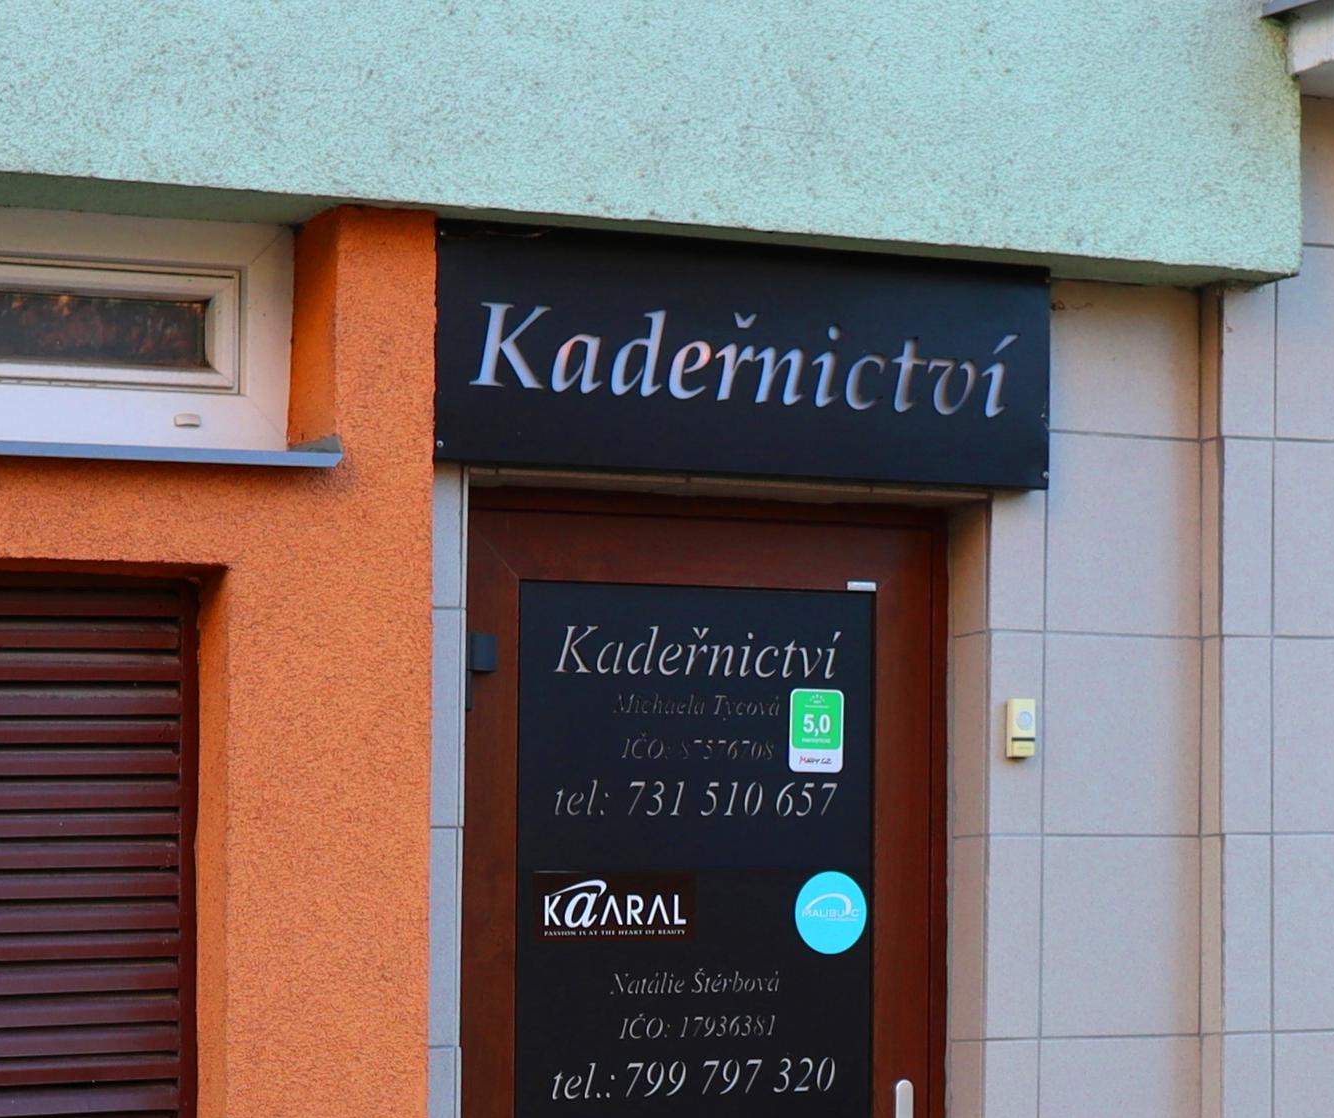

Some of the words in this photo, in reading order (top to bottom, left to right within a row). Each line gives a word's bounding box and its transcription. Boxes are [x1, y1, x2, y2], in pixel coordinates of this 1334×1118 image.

[469, 301, 1020, 419] Kadeřnictví
[554, 625, 841, 680] Kadeřnictví
[803, 713, 831, 737] 5,0
[627, 781, 686, 817] 731
[700, 782, 763, 817] 510
[775, 782, 838, 817] 657
[610, 971, 685, 995] Natálie
[619, 1013, 671, 1040] IČO:
[680, 1015, 776, 1038] 17936381
[552, 1063, 616, 1100] tel.:
[625, 1061, 687, 1097] 799
[702, 1059, 763, 1095] 797
[773, 1057, 836, 1093] 320
